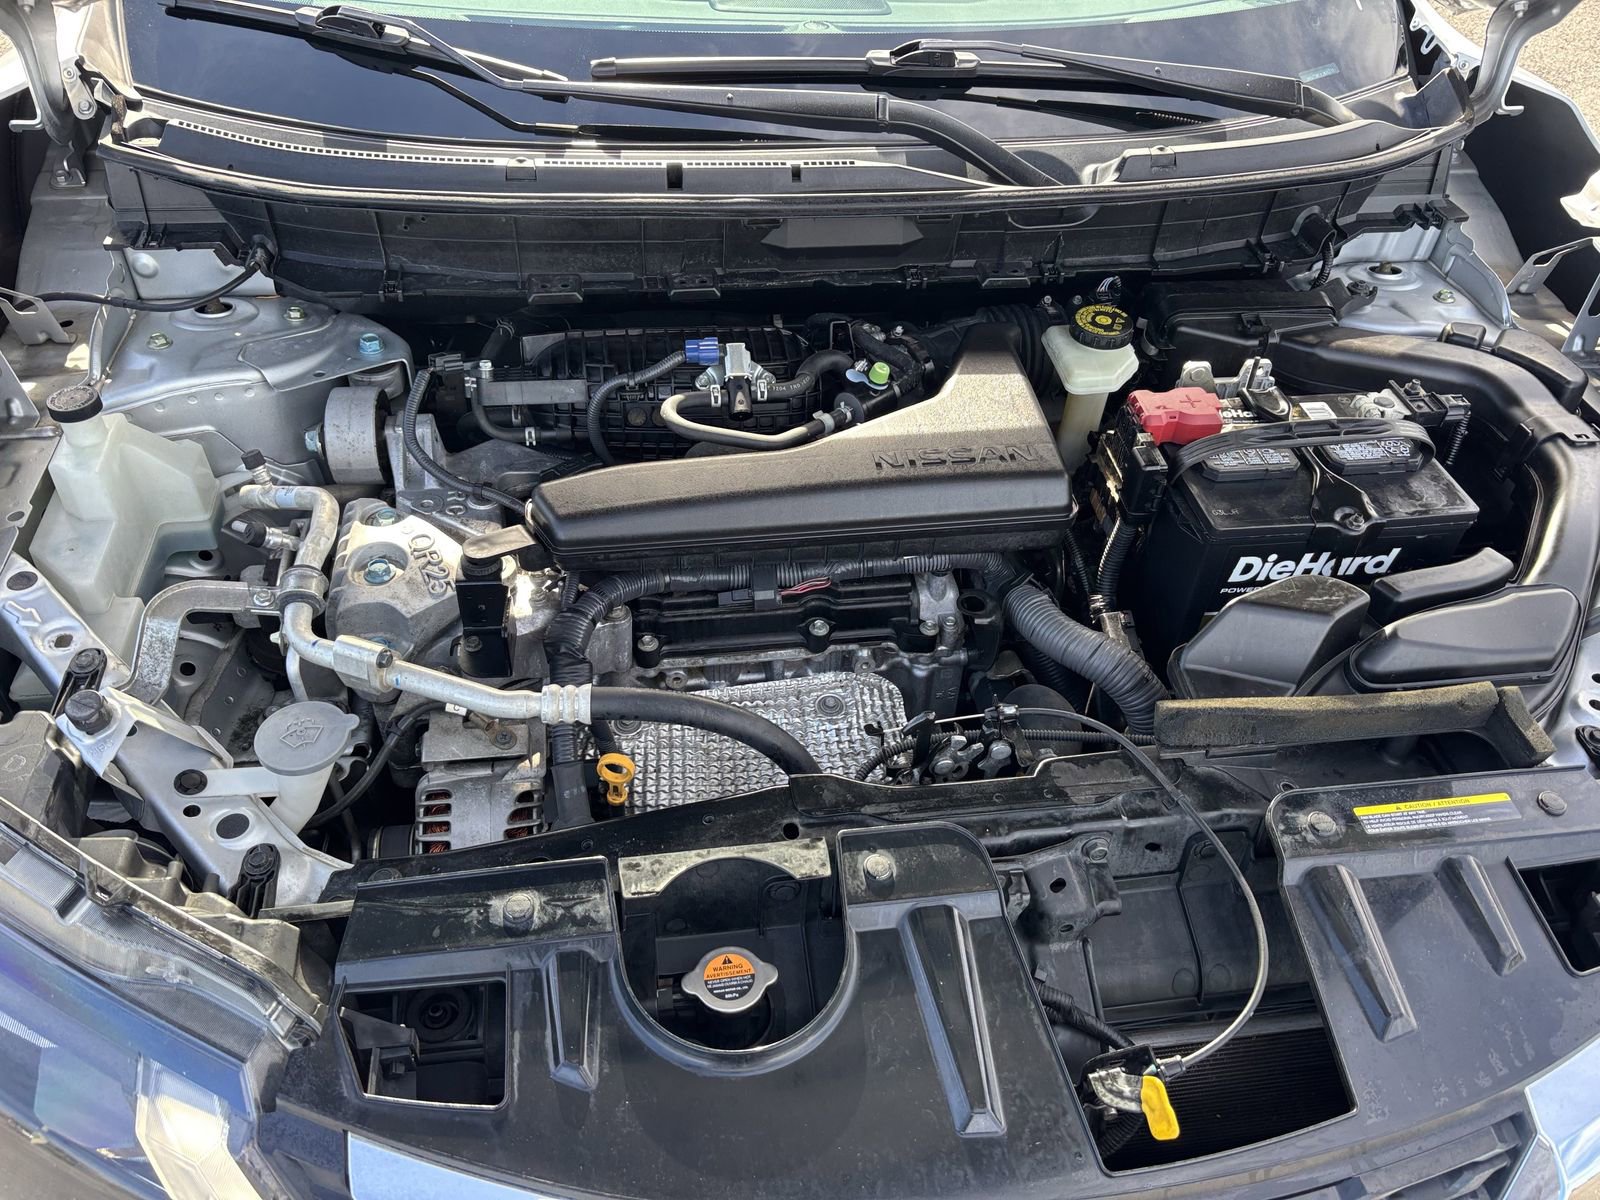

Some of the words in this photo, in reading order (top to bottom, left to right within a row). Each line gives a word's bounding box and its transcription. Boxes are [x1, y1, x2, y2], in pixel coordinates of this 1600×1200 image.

[872, 445, 1038, 470] NISSAN
[408, 533, 456, 599] QR25
[1227, 547, 1402, 583] DieHard
[1404, 802, 1432, 810] CAUTION
[1437, 798, 1471, 806] ATTENTION
[706, 968, 751, 978] AVERTISSEMENT
[712, 963, 743, 972] WARNING
